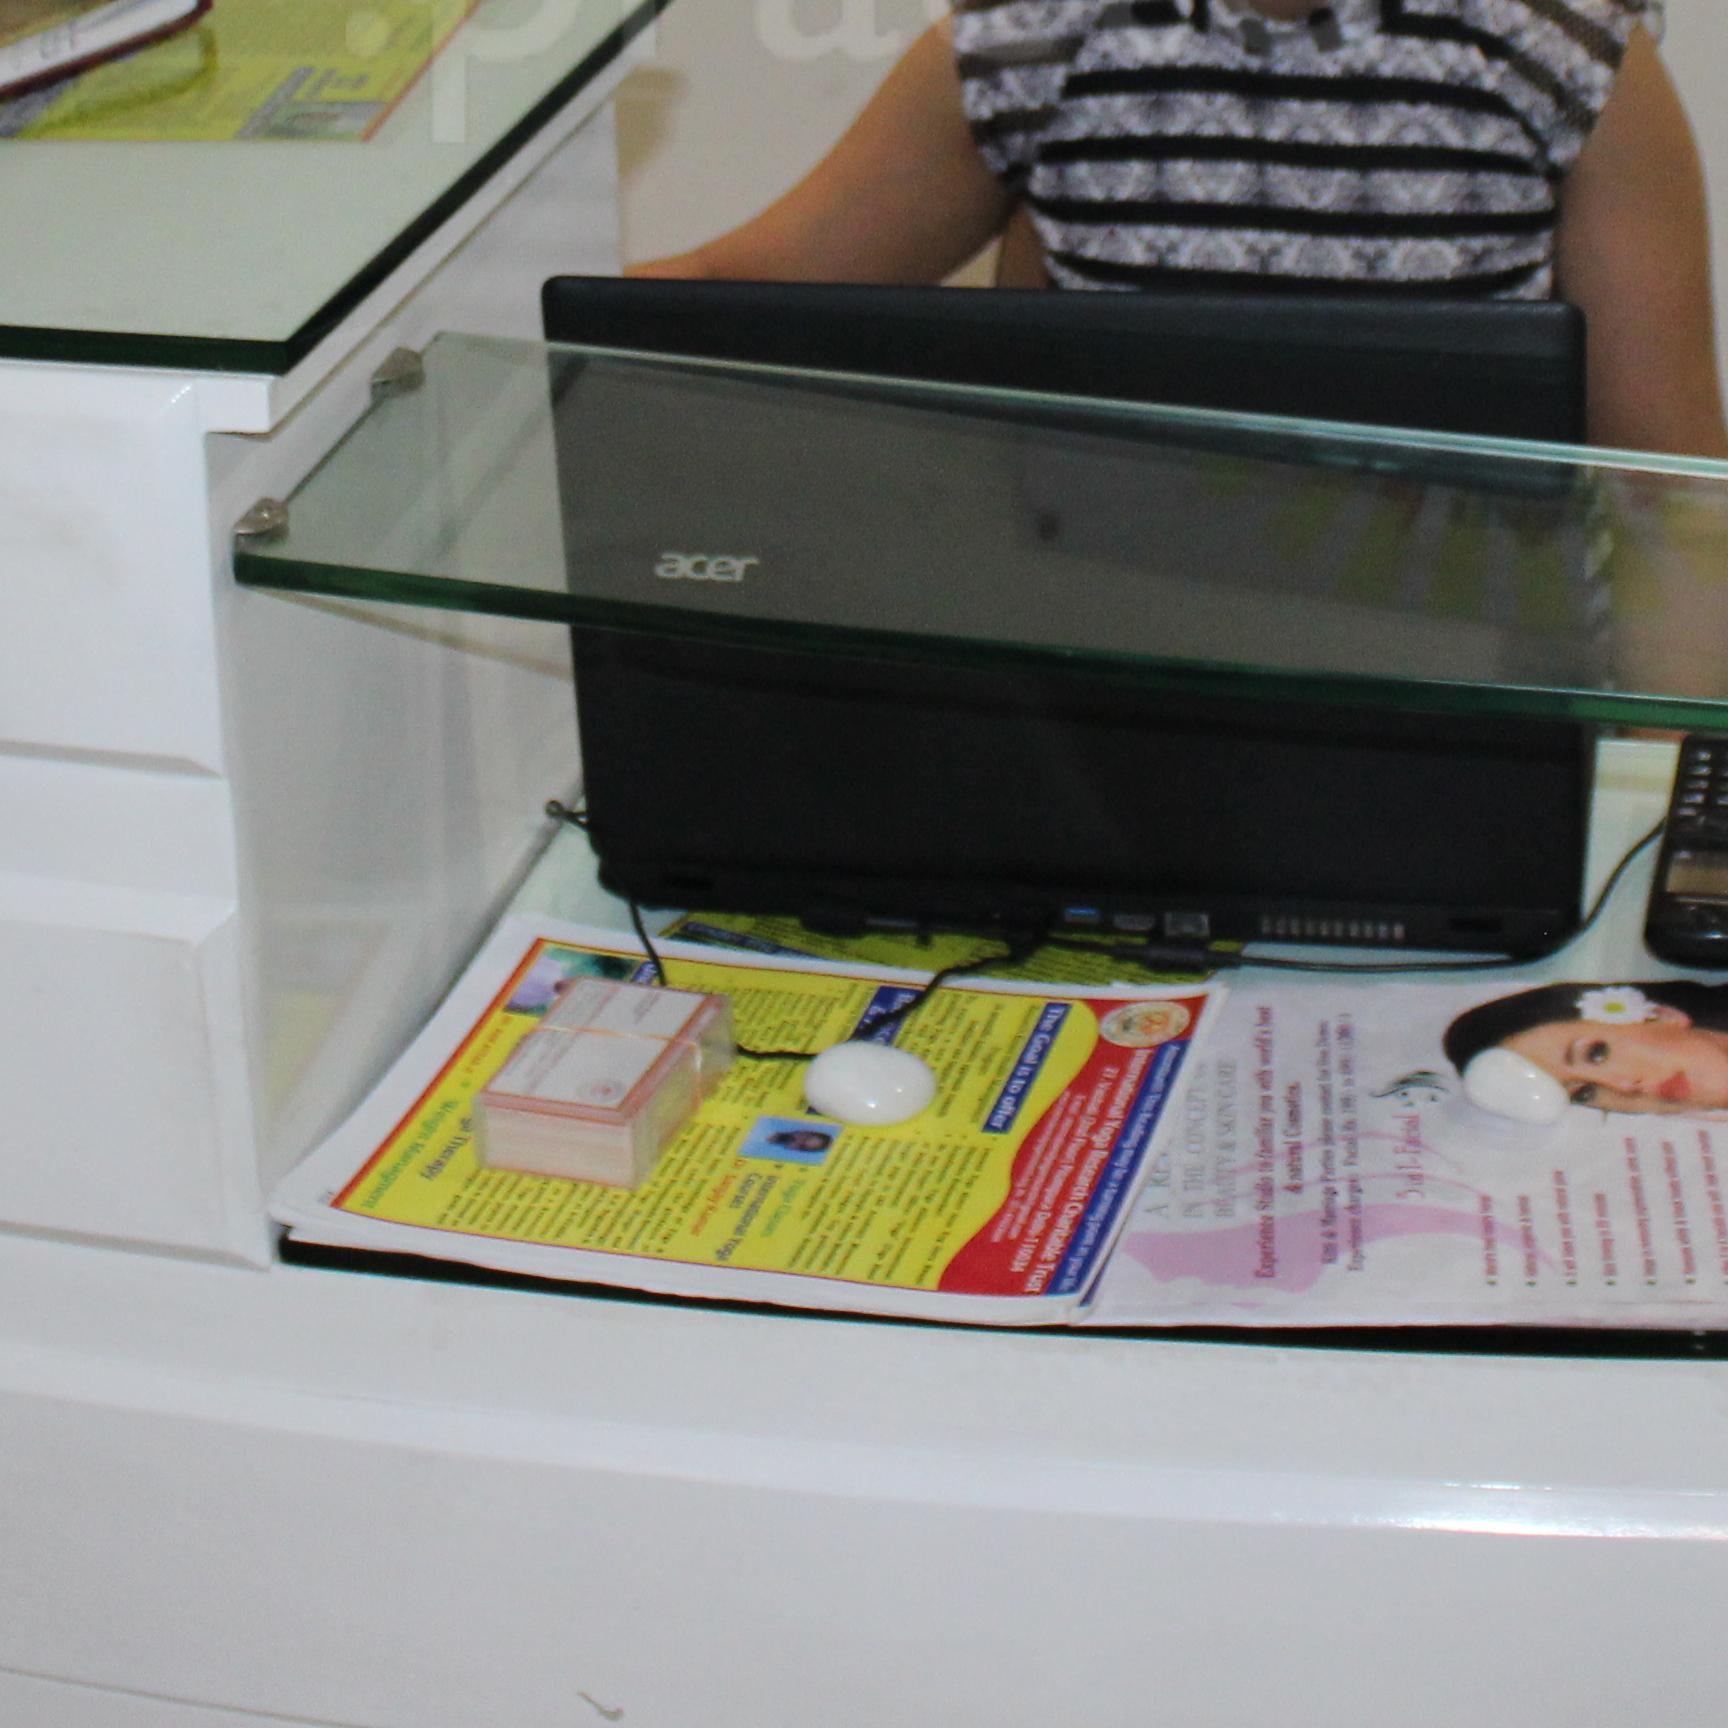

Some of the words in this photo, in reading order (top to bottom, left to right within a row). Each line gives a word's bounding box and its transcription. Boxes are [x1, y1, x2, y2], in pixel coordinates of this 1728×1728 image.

[655, 551, 761, 583] acer
[1041, 1007, 1064, 1031] The
[1024, 1033, 1050, 1064] Goal
[990, 1096, 1018, 1129] offer
[1090, 1118, 1120, 1148] Yoga
[1025, 1261, 1052, 1294] Trust
